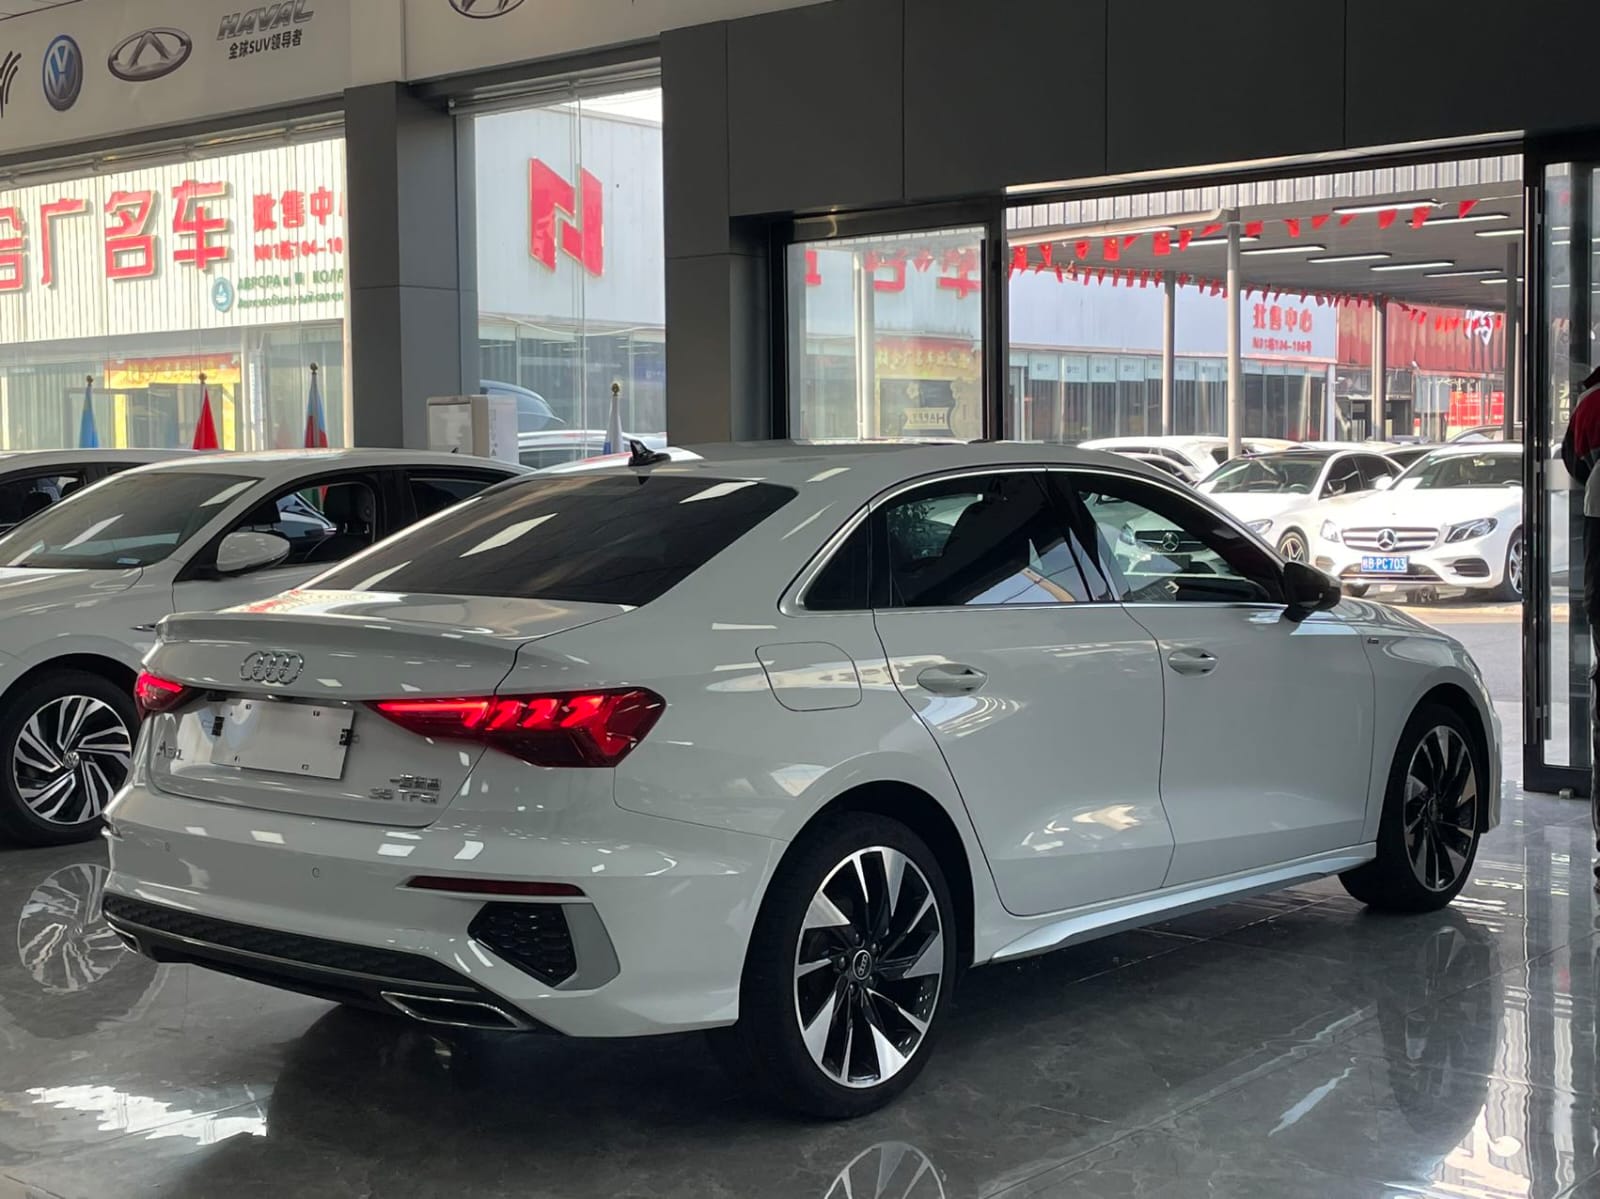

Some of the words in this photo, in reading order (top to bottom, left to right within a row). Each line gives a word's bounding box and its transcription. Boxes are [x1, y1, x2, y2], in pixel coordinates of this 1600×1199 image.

[217, 0, 314, 40] HAVAL
[228, 28, 303, 60] 全球SUV领导者
